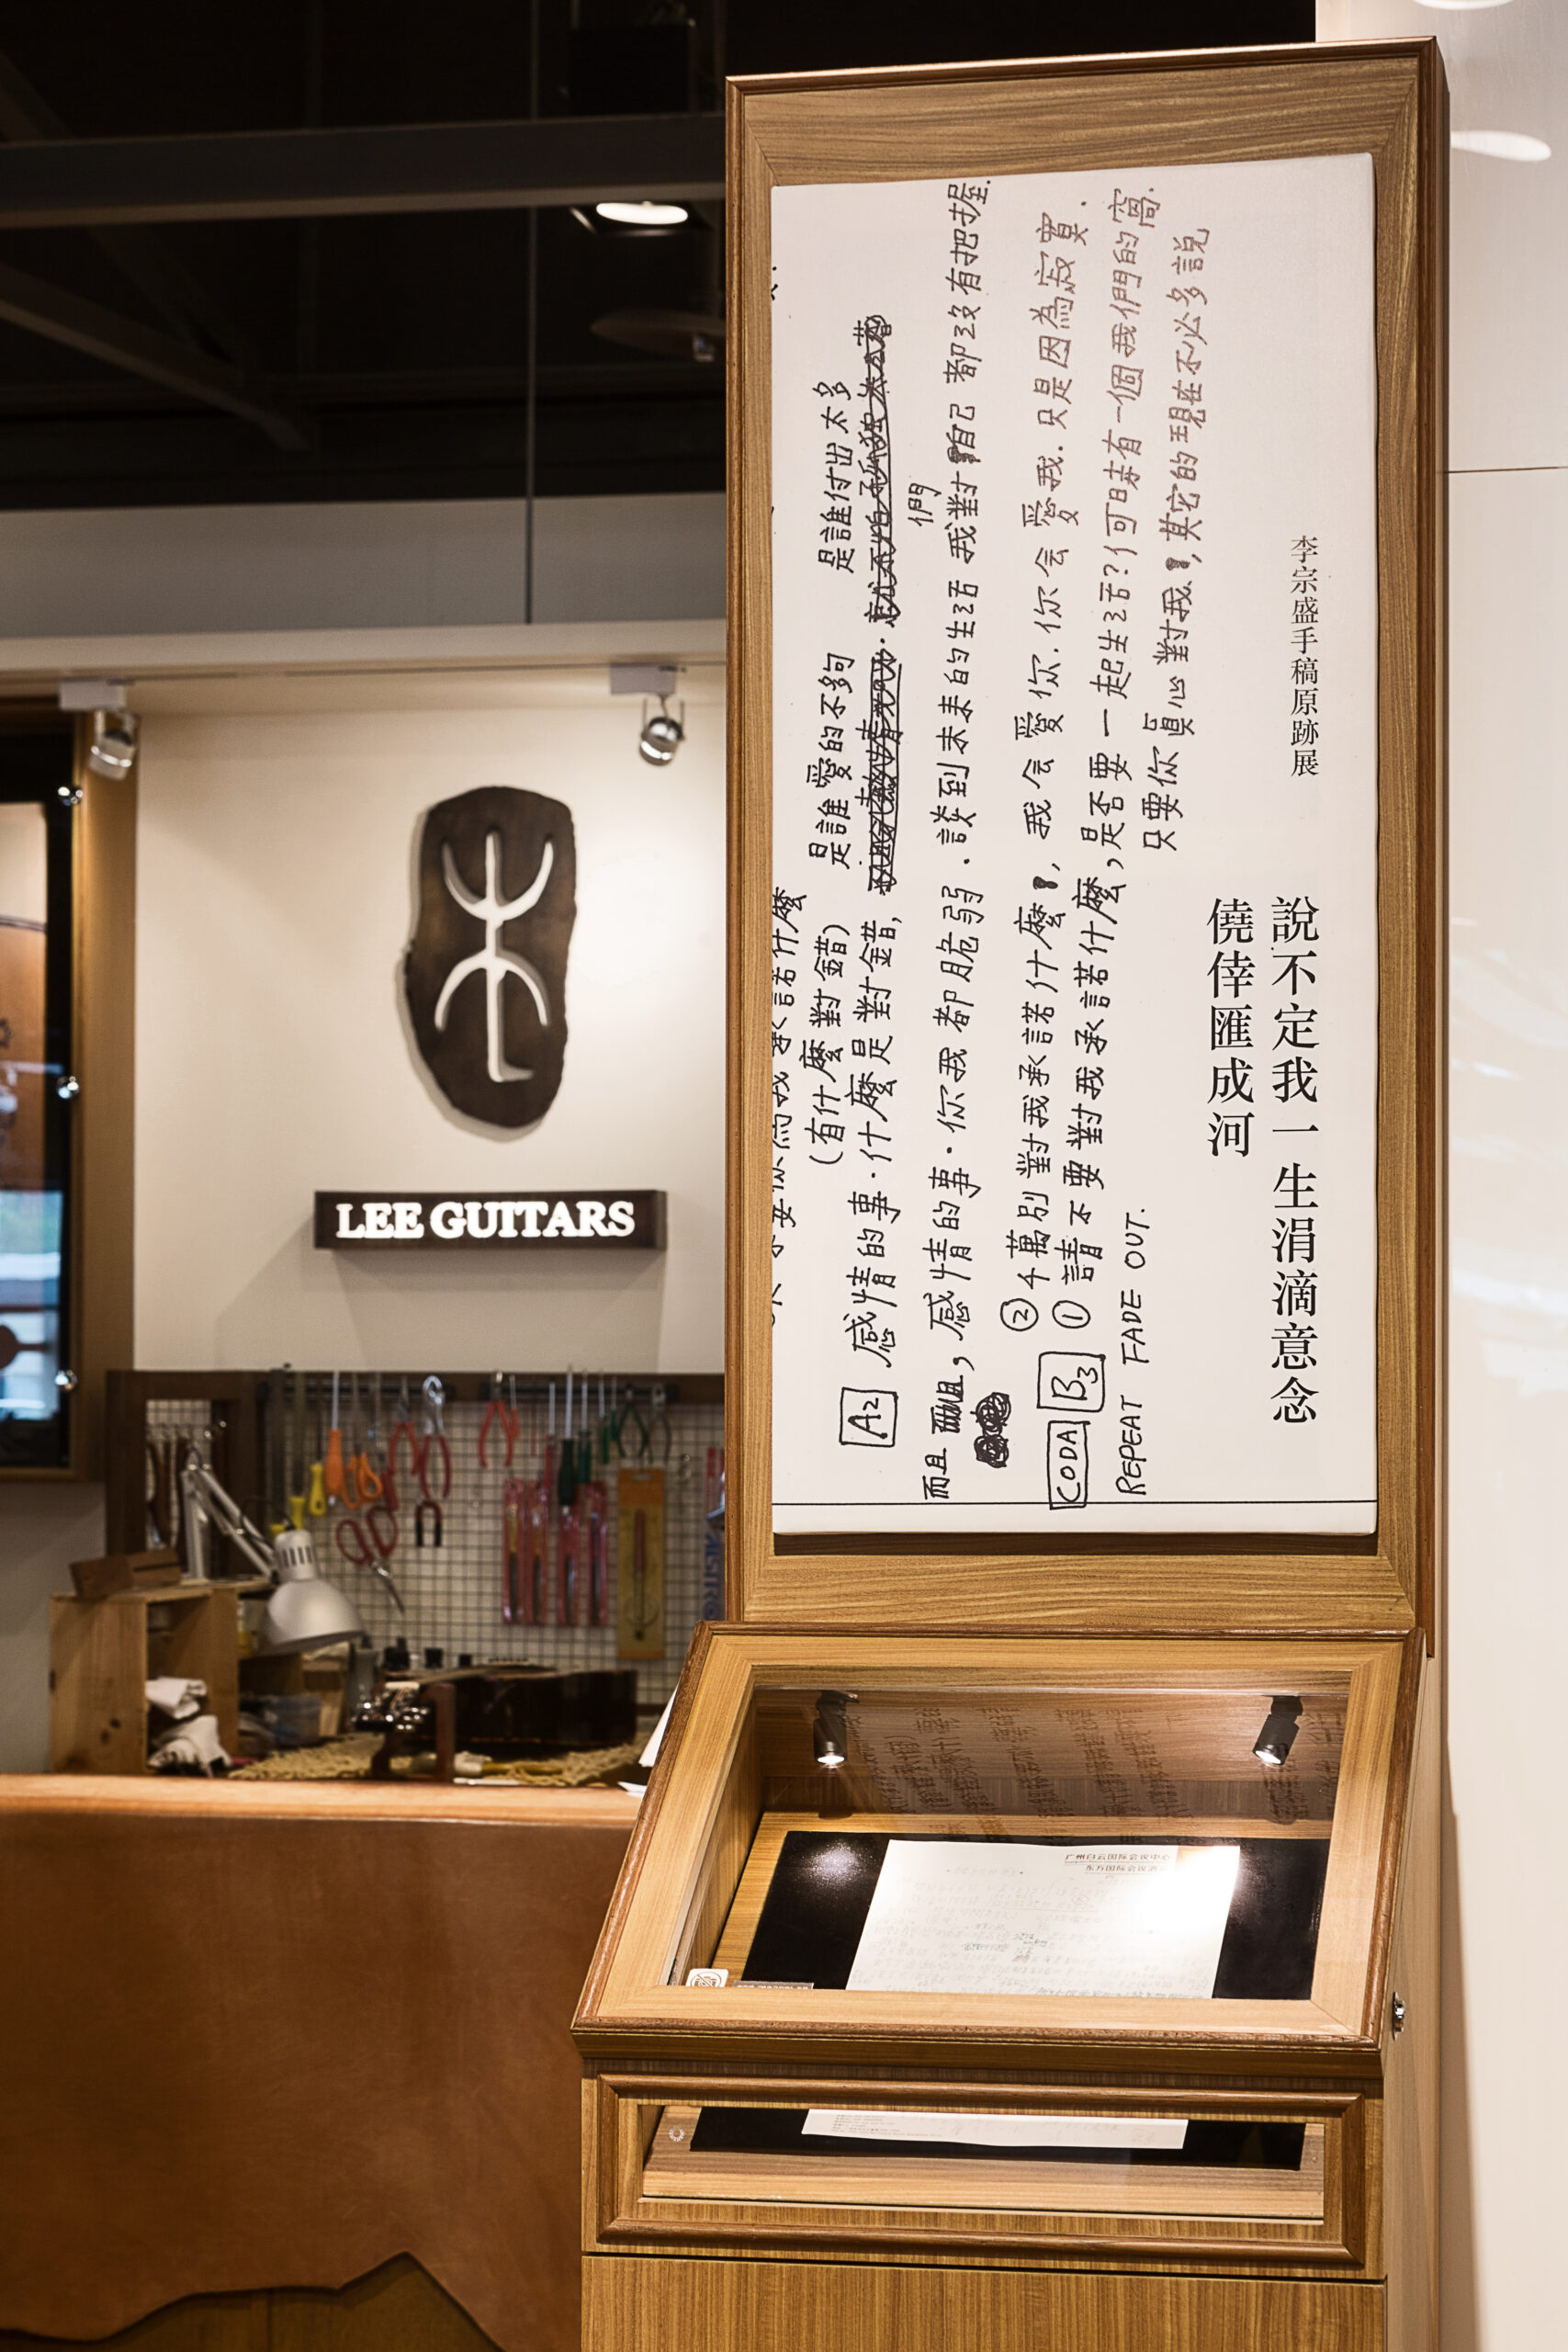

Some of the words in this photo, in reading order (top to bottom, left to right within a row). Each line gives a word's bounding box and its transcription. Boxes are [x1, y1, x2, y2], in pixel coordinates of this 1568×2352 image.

[1291, 535, 1319, 777] 李宗盛手稿原跡展
[1206, 897, 1255, 1158] 僥倖匯成河
[1270, 896, 1320, 1423] 說不定我一生涓滴意念
[335, 1202, 424, 1238] LEE
[429, 1200, 636, 1238] GUITARS
[1121, 1288, 1150, 1364] FADE
[1056, 1430, 1080, 1503] CODA
[1116, 1395, 1147, 1496] REPEAT
